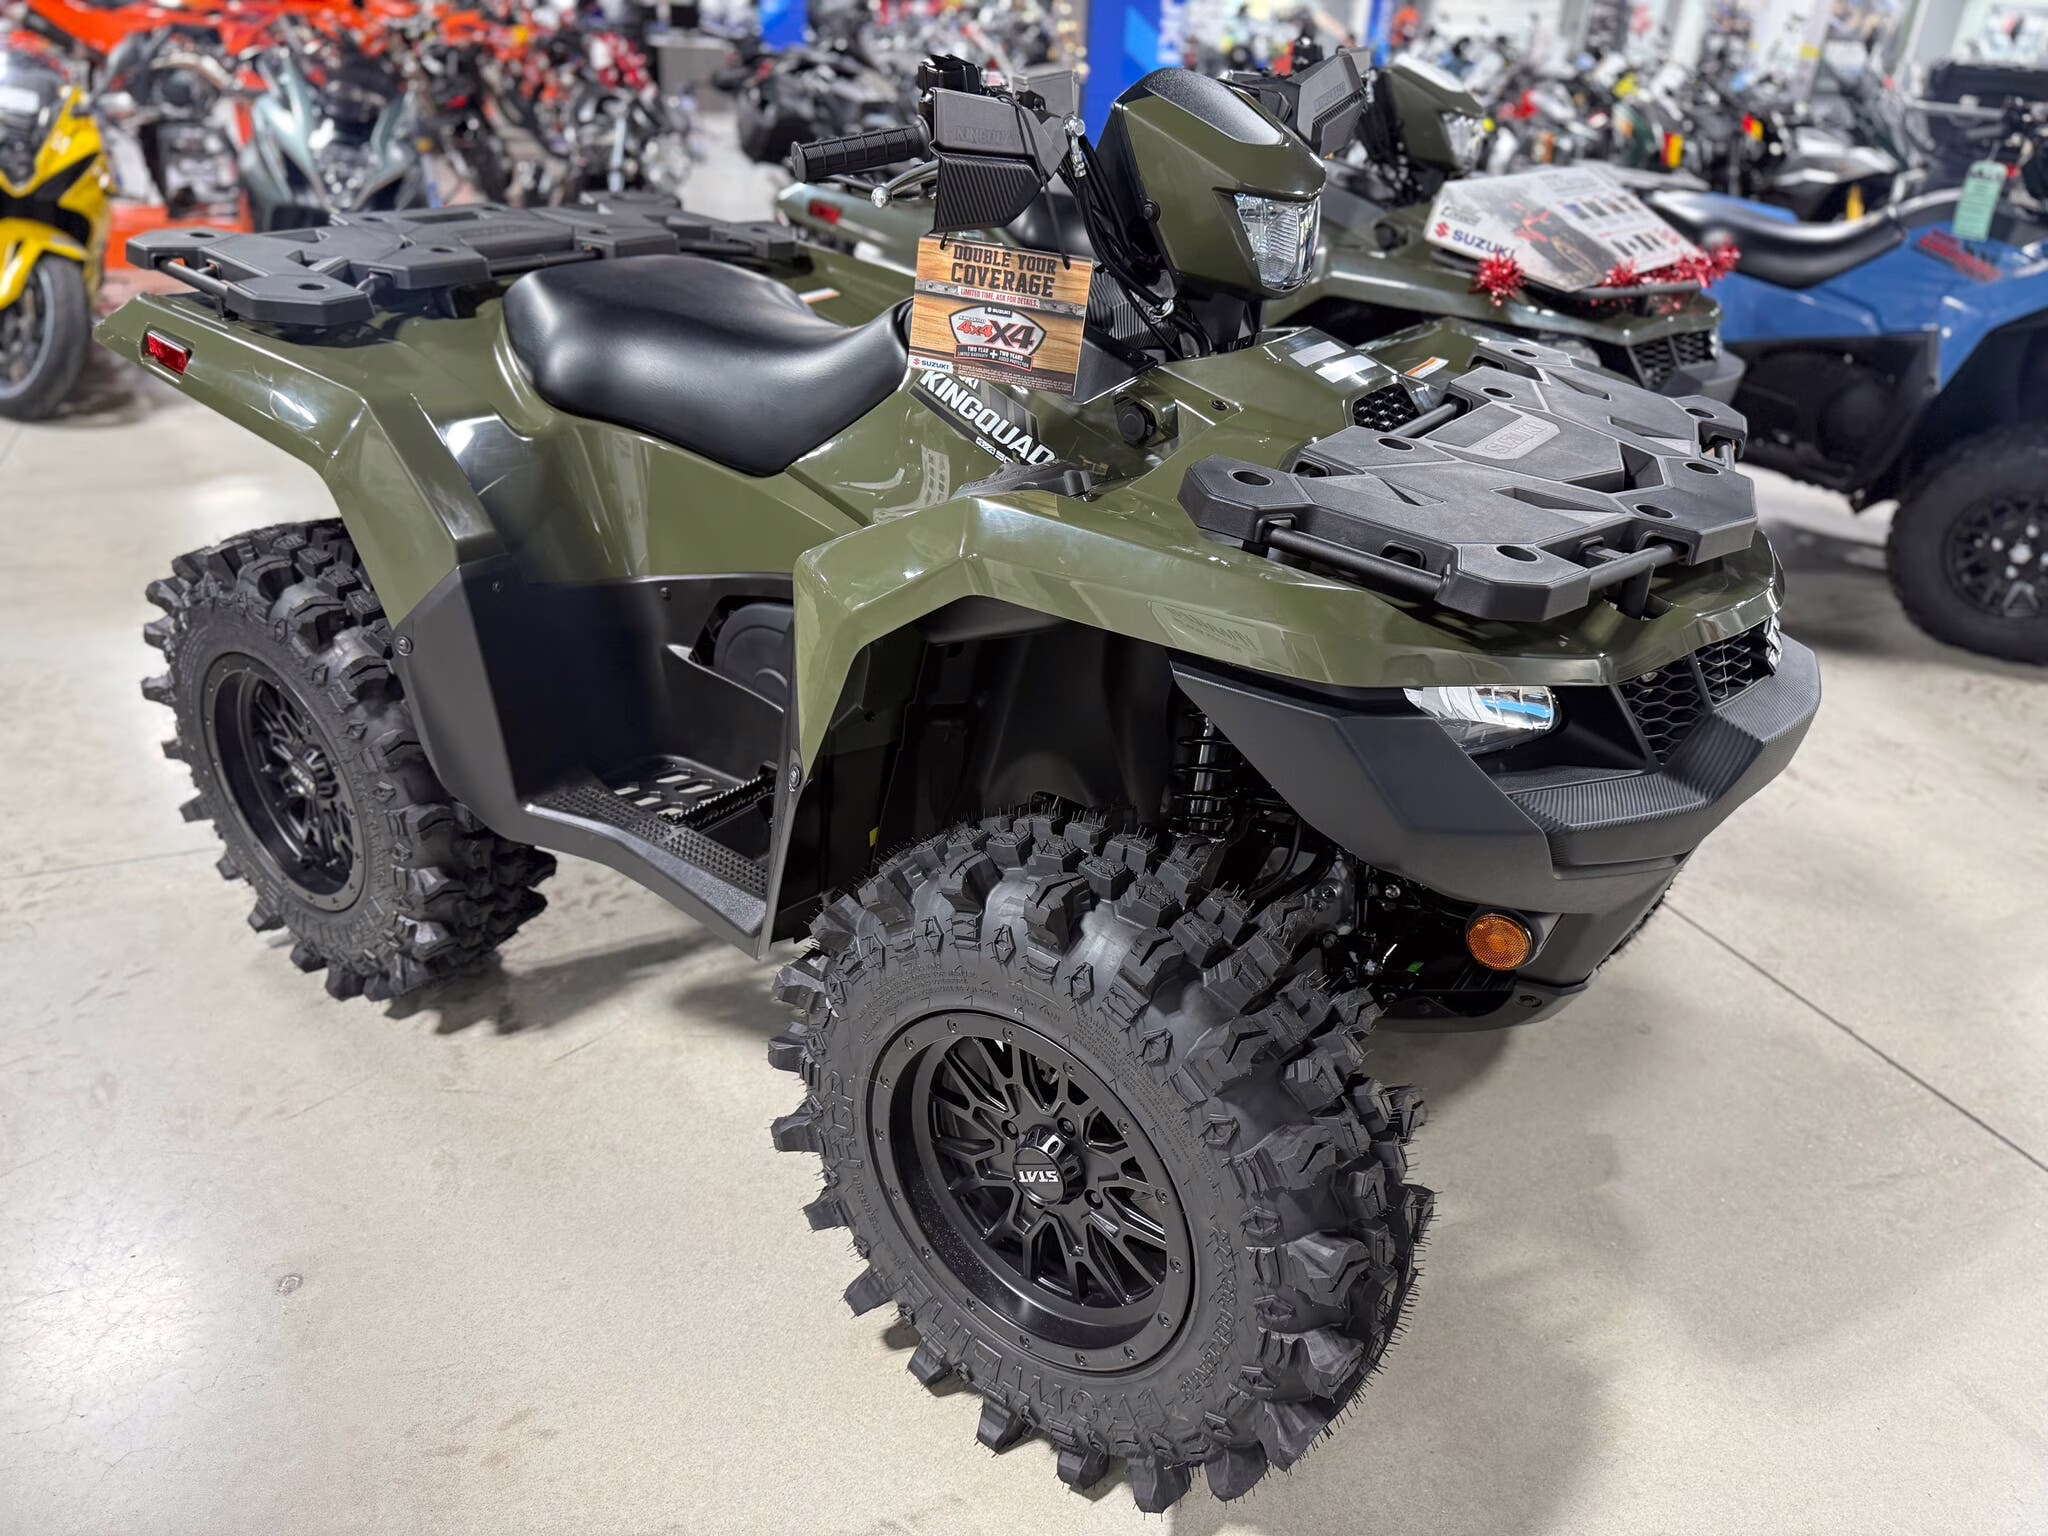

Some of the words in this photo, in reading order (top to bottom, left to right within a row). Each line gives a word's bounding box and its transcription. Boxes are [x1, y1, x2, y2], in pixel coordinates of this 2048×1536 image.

[1452, 229, 1516, 259] SUZUKI
[953, 244, 1012, 268] DOUBLE
[1017, 254, 1057, 276] YOUR
[951, 262, 1056, 298] COVERAGE
[960, 287, 981, 298] LIMITED
[995, 294, 1007, 302] ASK
[1006, 295, 1017, 304] FOR
[992, 308, 1011, 316] SUZUKI
[921, 360, 950, 370] SUZUKI
[999, 350, 1010, 358] TWO
[1010, 352, 1024, 361] YEARS
[919, 370, 1056, 465] KINGQUAD
[1485, 422, 1548, 455] SUZUKI
